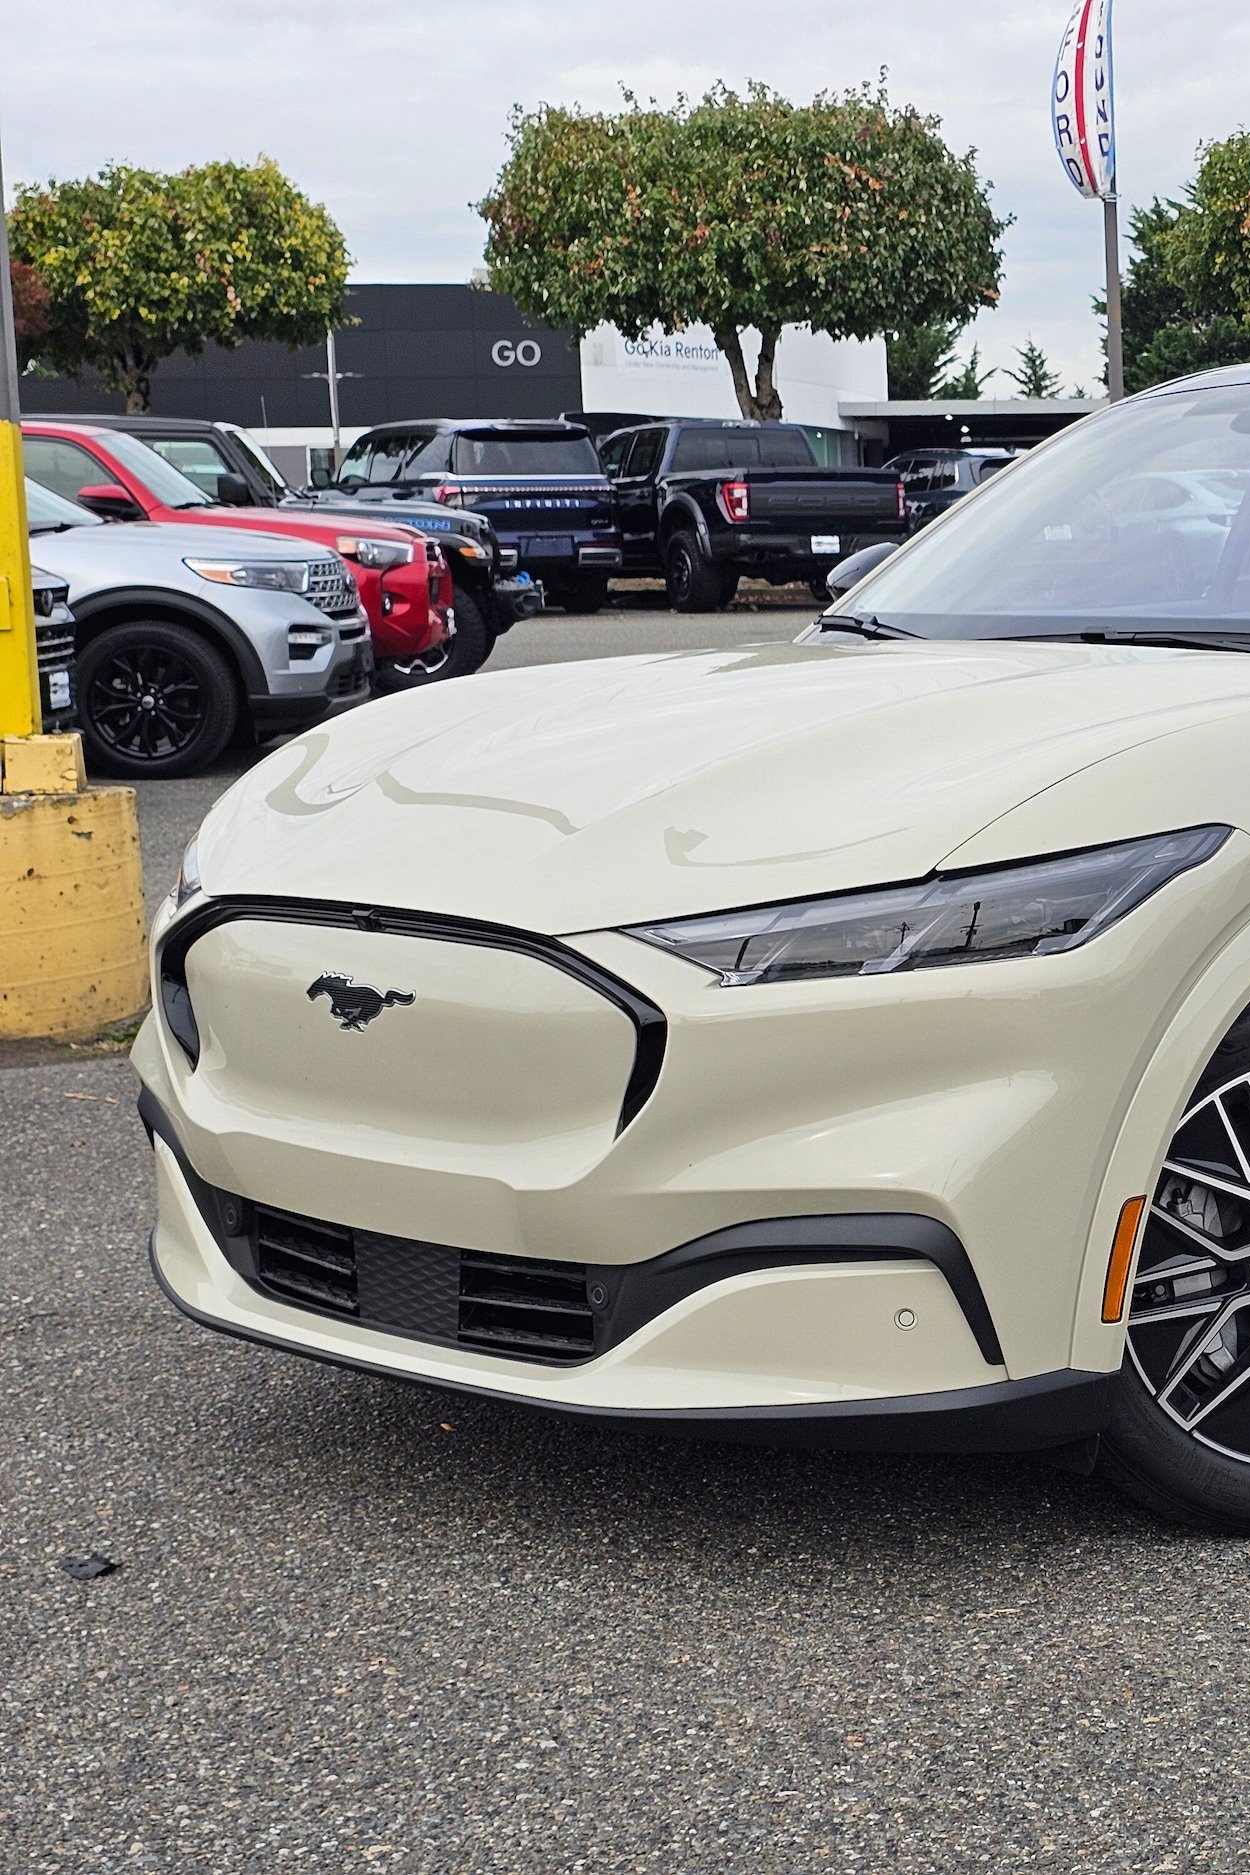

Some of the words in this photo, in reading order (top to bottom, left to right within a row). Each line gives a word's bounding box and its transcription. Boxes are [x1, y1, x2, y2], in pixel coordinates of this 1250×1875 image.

[1055, 27, 1085, 188] FORD
[491, 338, 542, 367] GO
[649, 340, 672, 358] Kia
[675, 341, 720, 361] Renton
